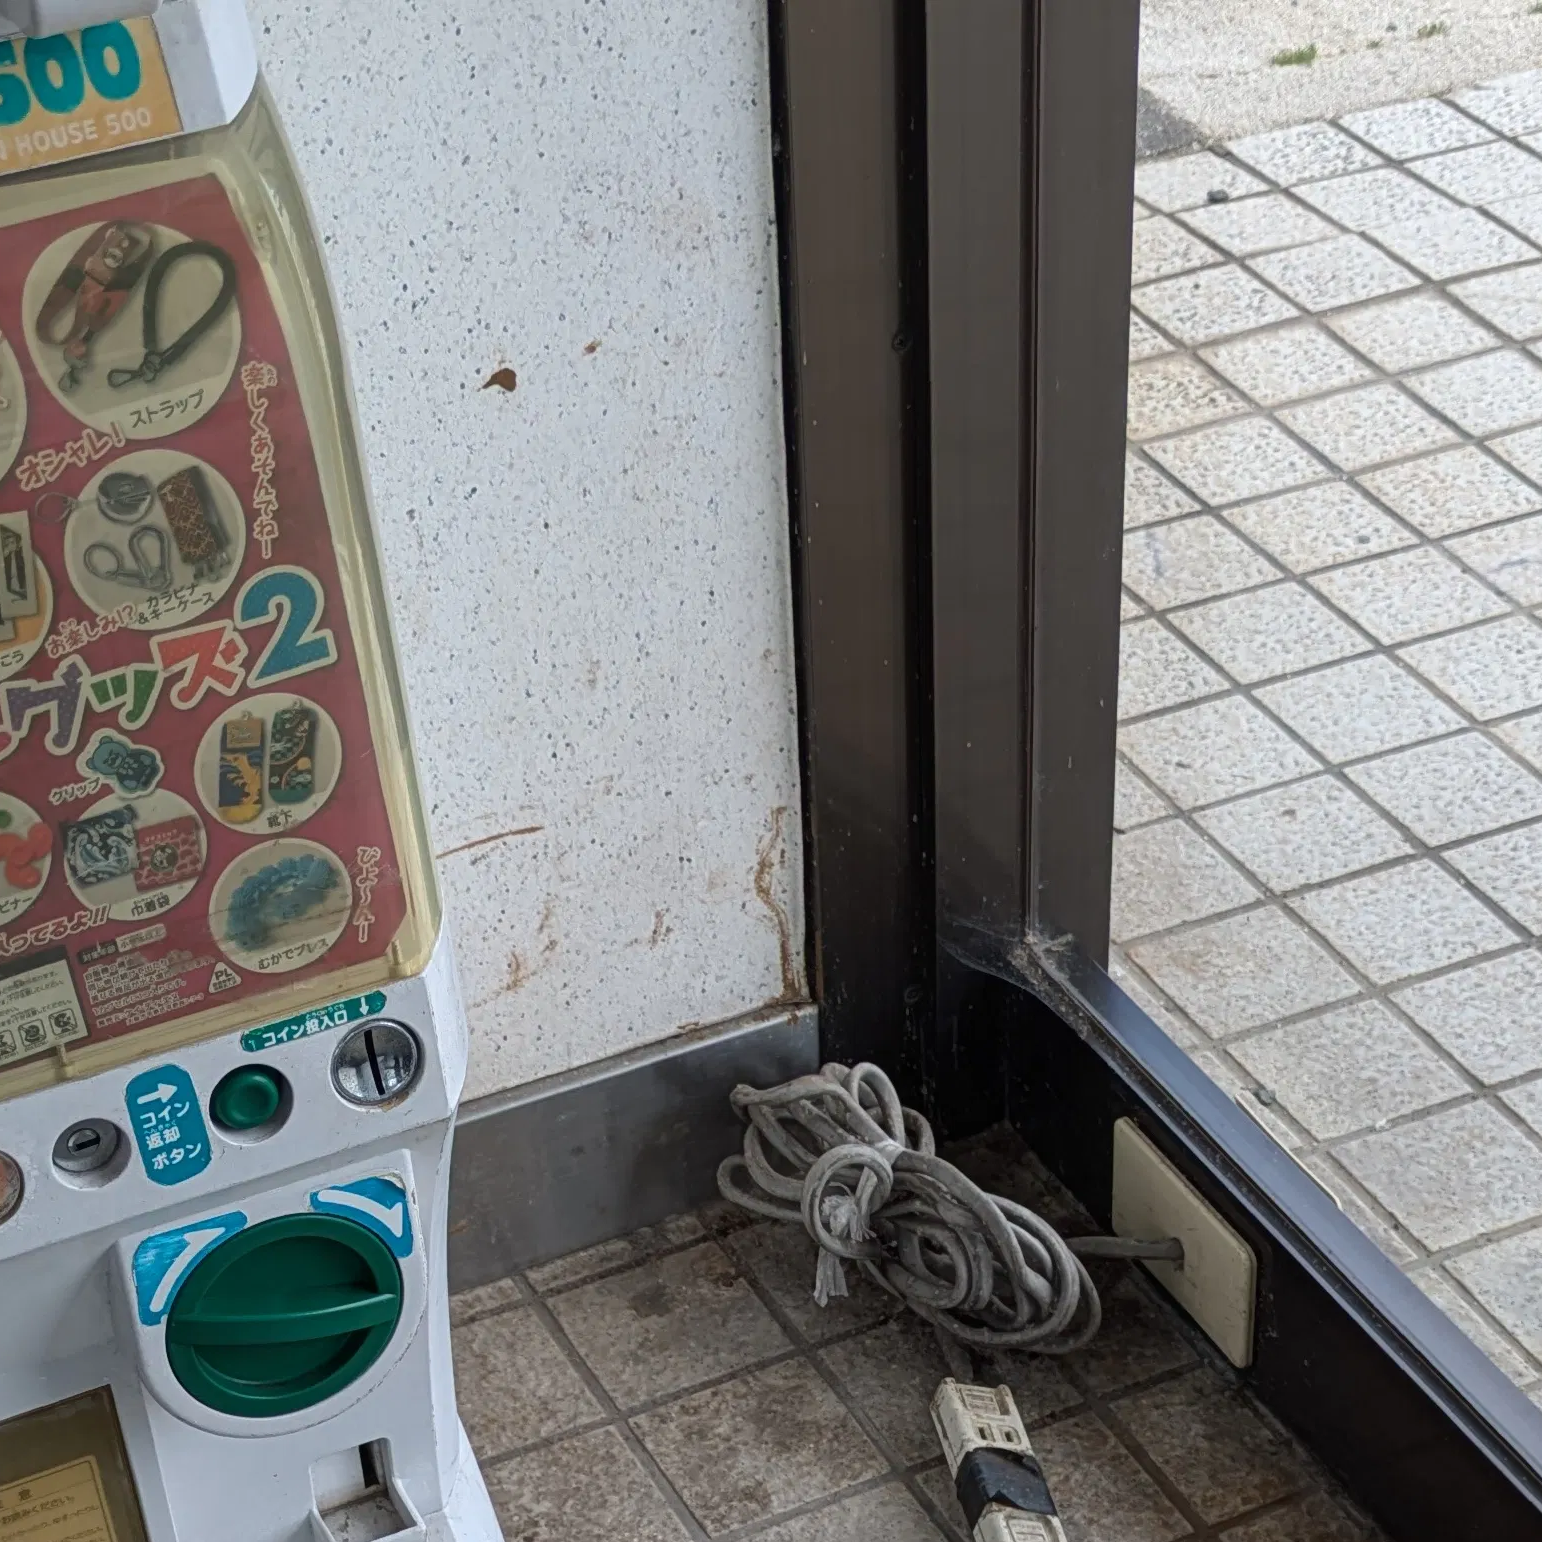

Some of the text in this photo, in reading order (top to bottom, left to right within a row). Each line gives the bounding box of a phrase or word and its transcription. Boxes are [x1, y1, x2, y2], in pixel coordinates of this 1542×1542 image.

[15, 118, 101, 154] HOUSE
[107, 107, 153, 134] 500
[129, 389, 205, 428] ストラップ
[146, 583, 199, 609] カラビナ
[49, 777, 102, 805] クリップ
[214, 967, 233, 981] PL
[262, 1010, 348, 1047] コイン投入口
[140, 1101, 190, 1129] コイン
[145, 1126, 181, 1151] 返却
[151, 1143, 202, 1170] ボタン
